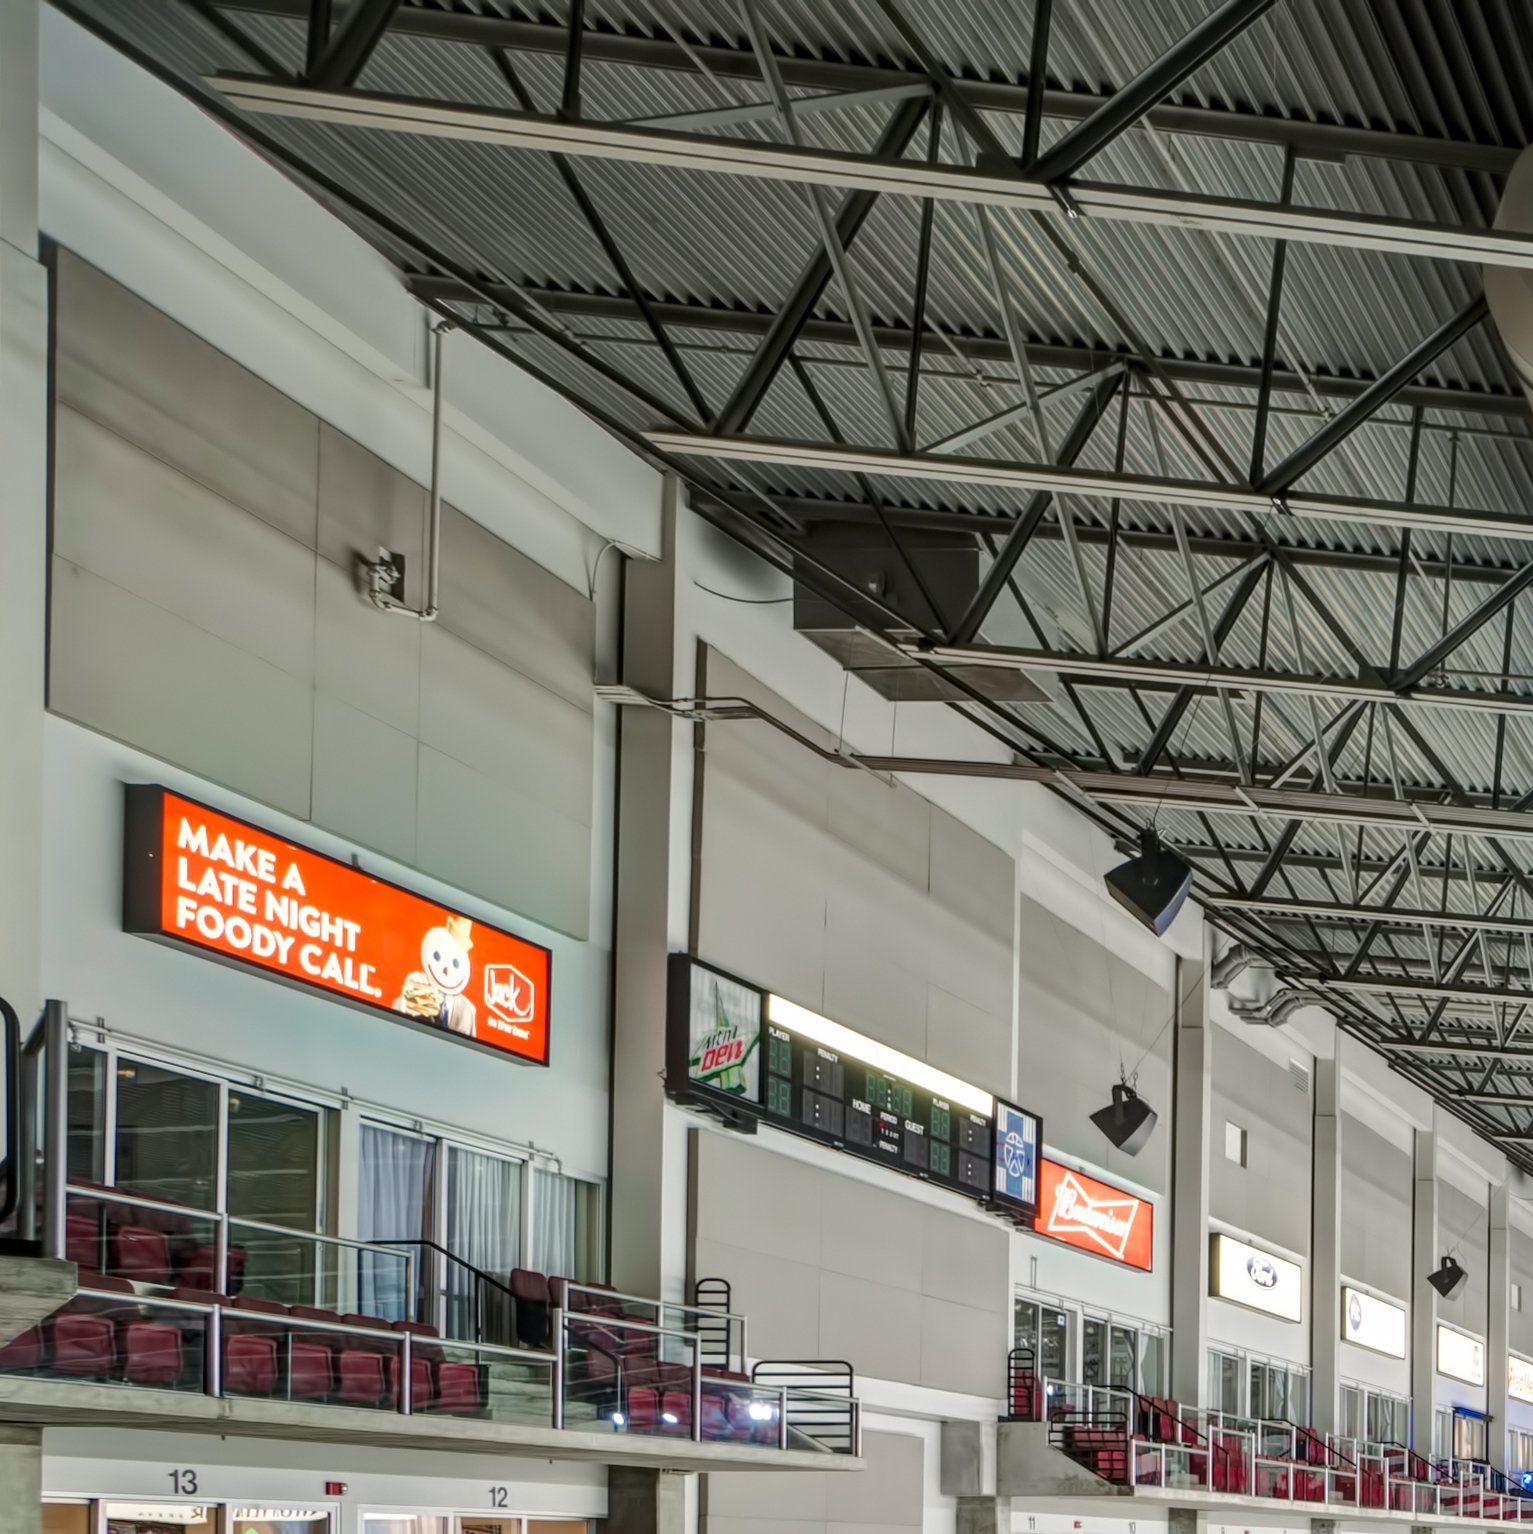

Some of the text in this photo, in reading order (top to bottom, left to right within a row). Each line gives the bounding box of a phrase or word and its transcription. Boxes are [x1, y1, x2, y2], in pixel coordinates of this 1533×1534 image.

[177, 817, 306, 896] MAKE A
[177, 856, 361, 953] LATE NIGHT
[176, 896, 295, 965] FOODY
[487, 976, 533, 1018] Jack
[487, 1017, 530, 1041] in the box
[769, 1027, 790, 1042] PLAYER
[818, 1048, 838, 1064] PENALTY
[852, 1099, 871, 1115] HOME
[880, 1111, 898, 1125] PERIOD
[905, 1120, 924, 1135] GUEST
[1055, 1183, 1130, 1238] Budweiser
[168, 1470, 198, 1494] 13
[488, 1487, 508, 1508] 12
[1028, 1516, 1036, 1530] 11
[1129, 1521, 1137, 1534] 10
